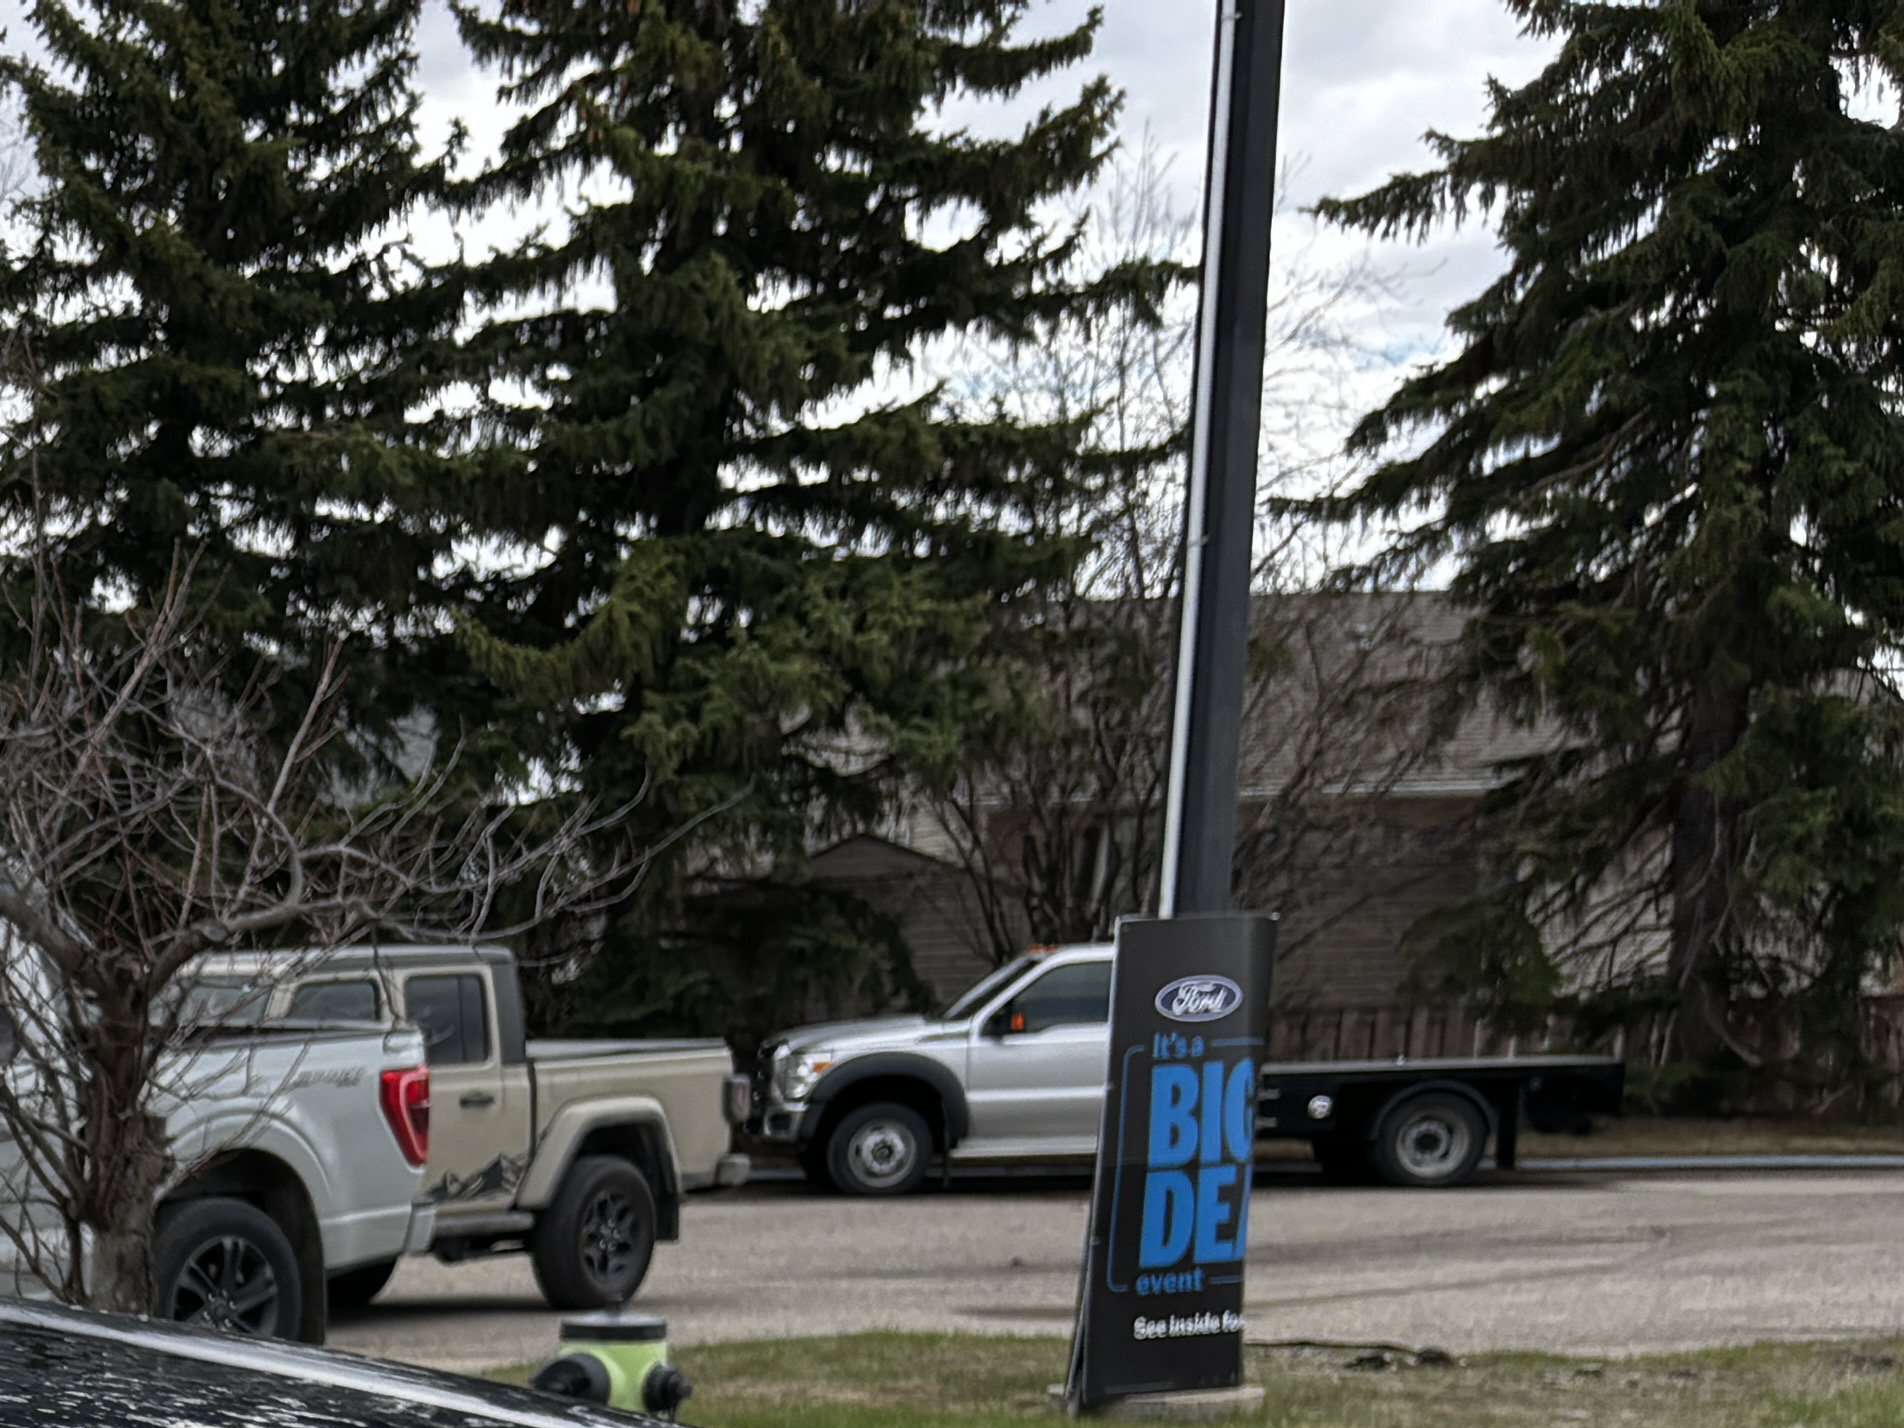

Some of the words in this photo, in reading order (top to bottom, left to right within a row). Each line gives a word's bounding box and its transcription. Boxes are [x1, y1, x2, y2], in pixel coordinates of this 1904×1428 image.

[1153, 1031, 1188, 1059] It's
[1135, 1266, 1206, 1296] event
[1133, 1316, 1168, 1340] See
